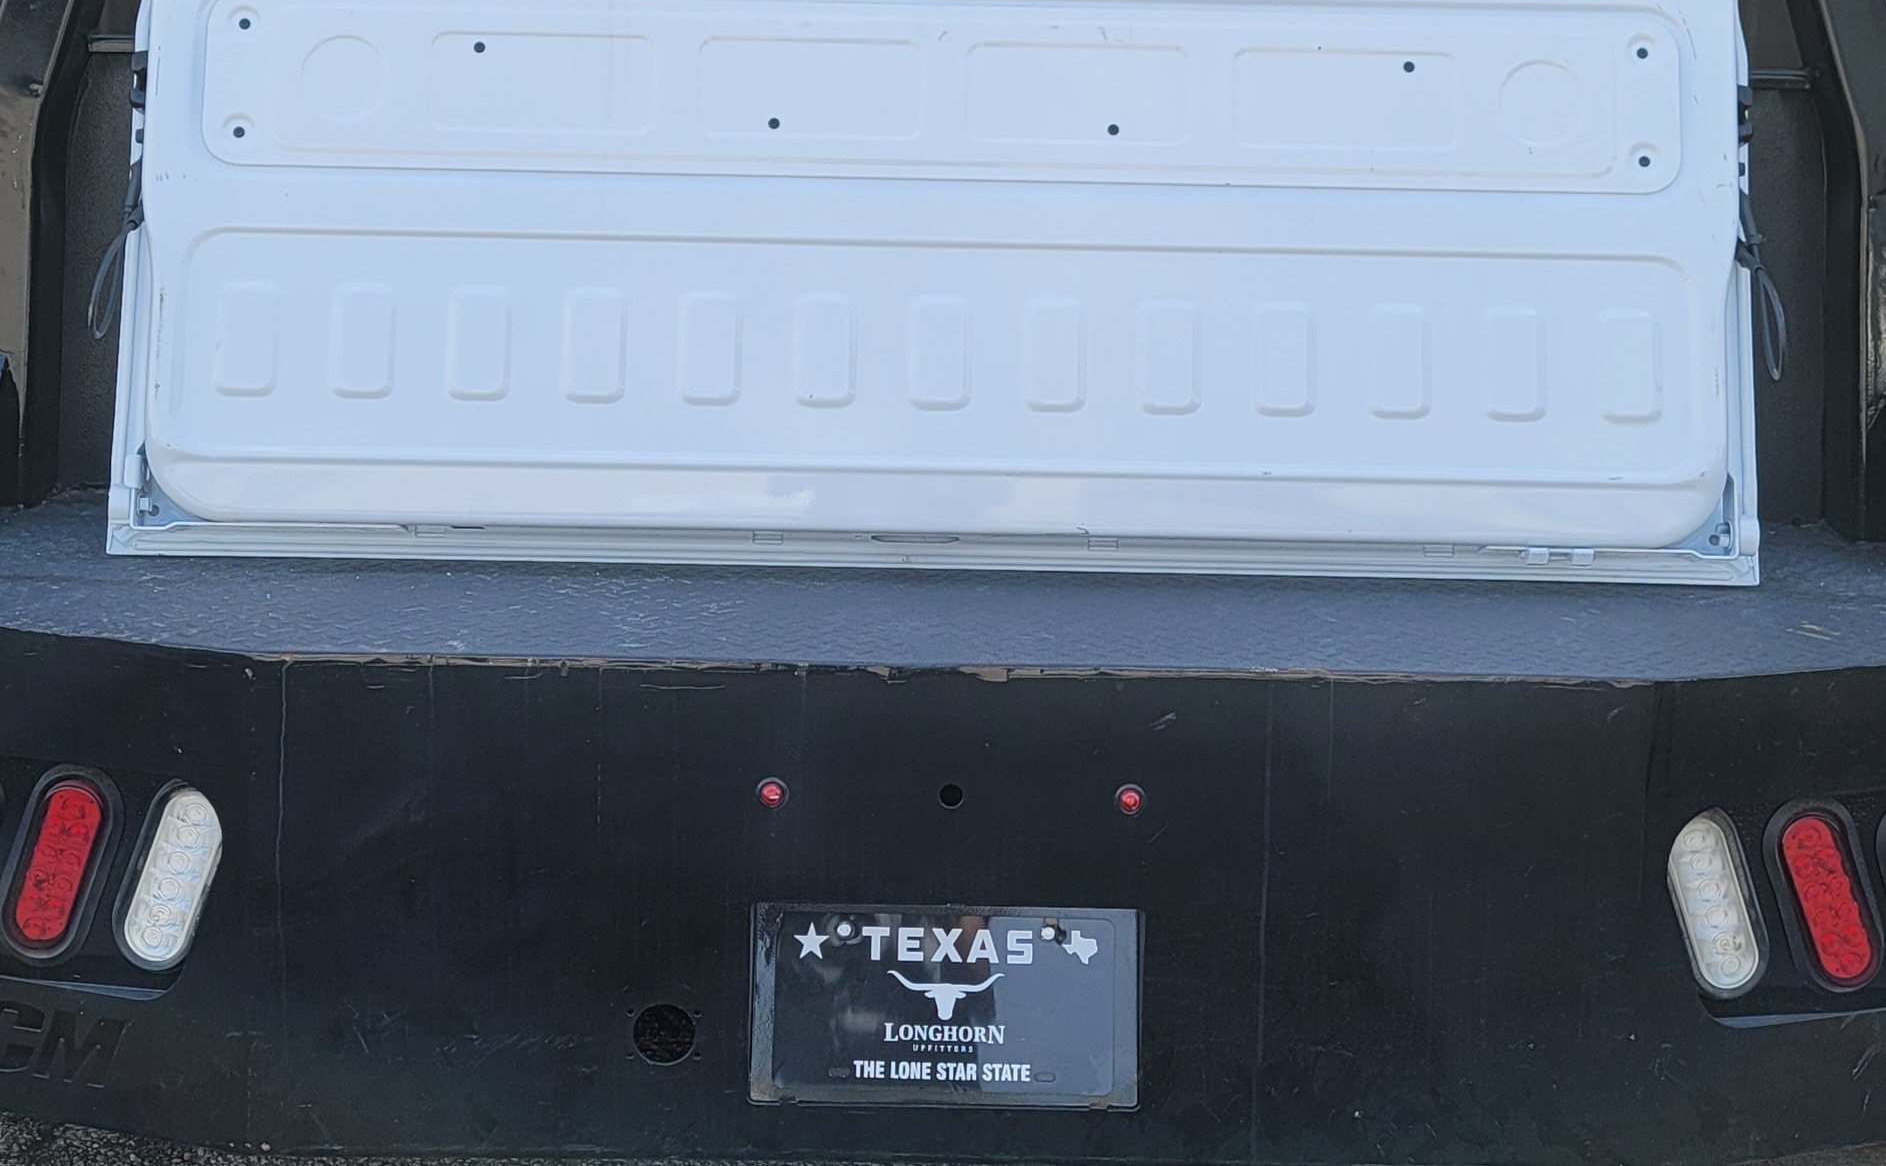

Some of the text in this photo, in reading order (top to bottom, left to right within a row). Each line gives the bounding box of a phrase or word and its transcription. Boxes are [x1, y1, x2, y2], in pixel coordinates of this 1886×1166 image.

[862, 926, 1034, 965] TEXAS
[883, 1022, 1005, 1044] LONGHORN
[912, 1044, 974, 1053] UPFITTERS
[853, 1059, 1031, 1082] THE LONE STAR STATE
